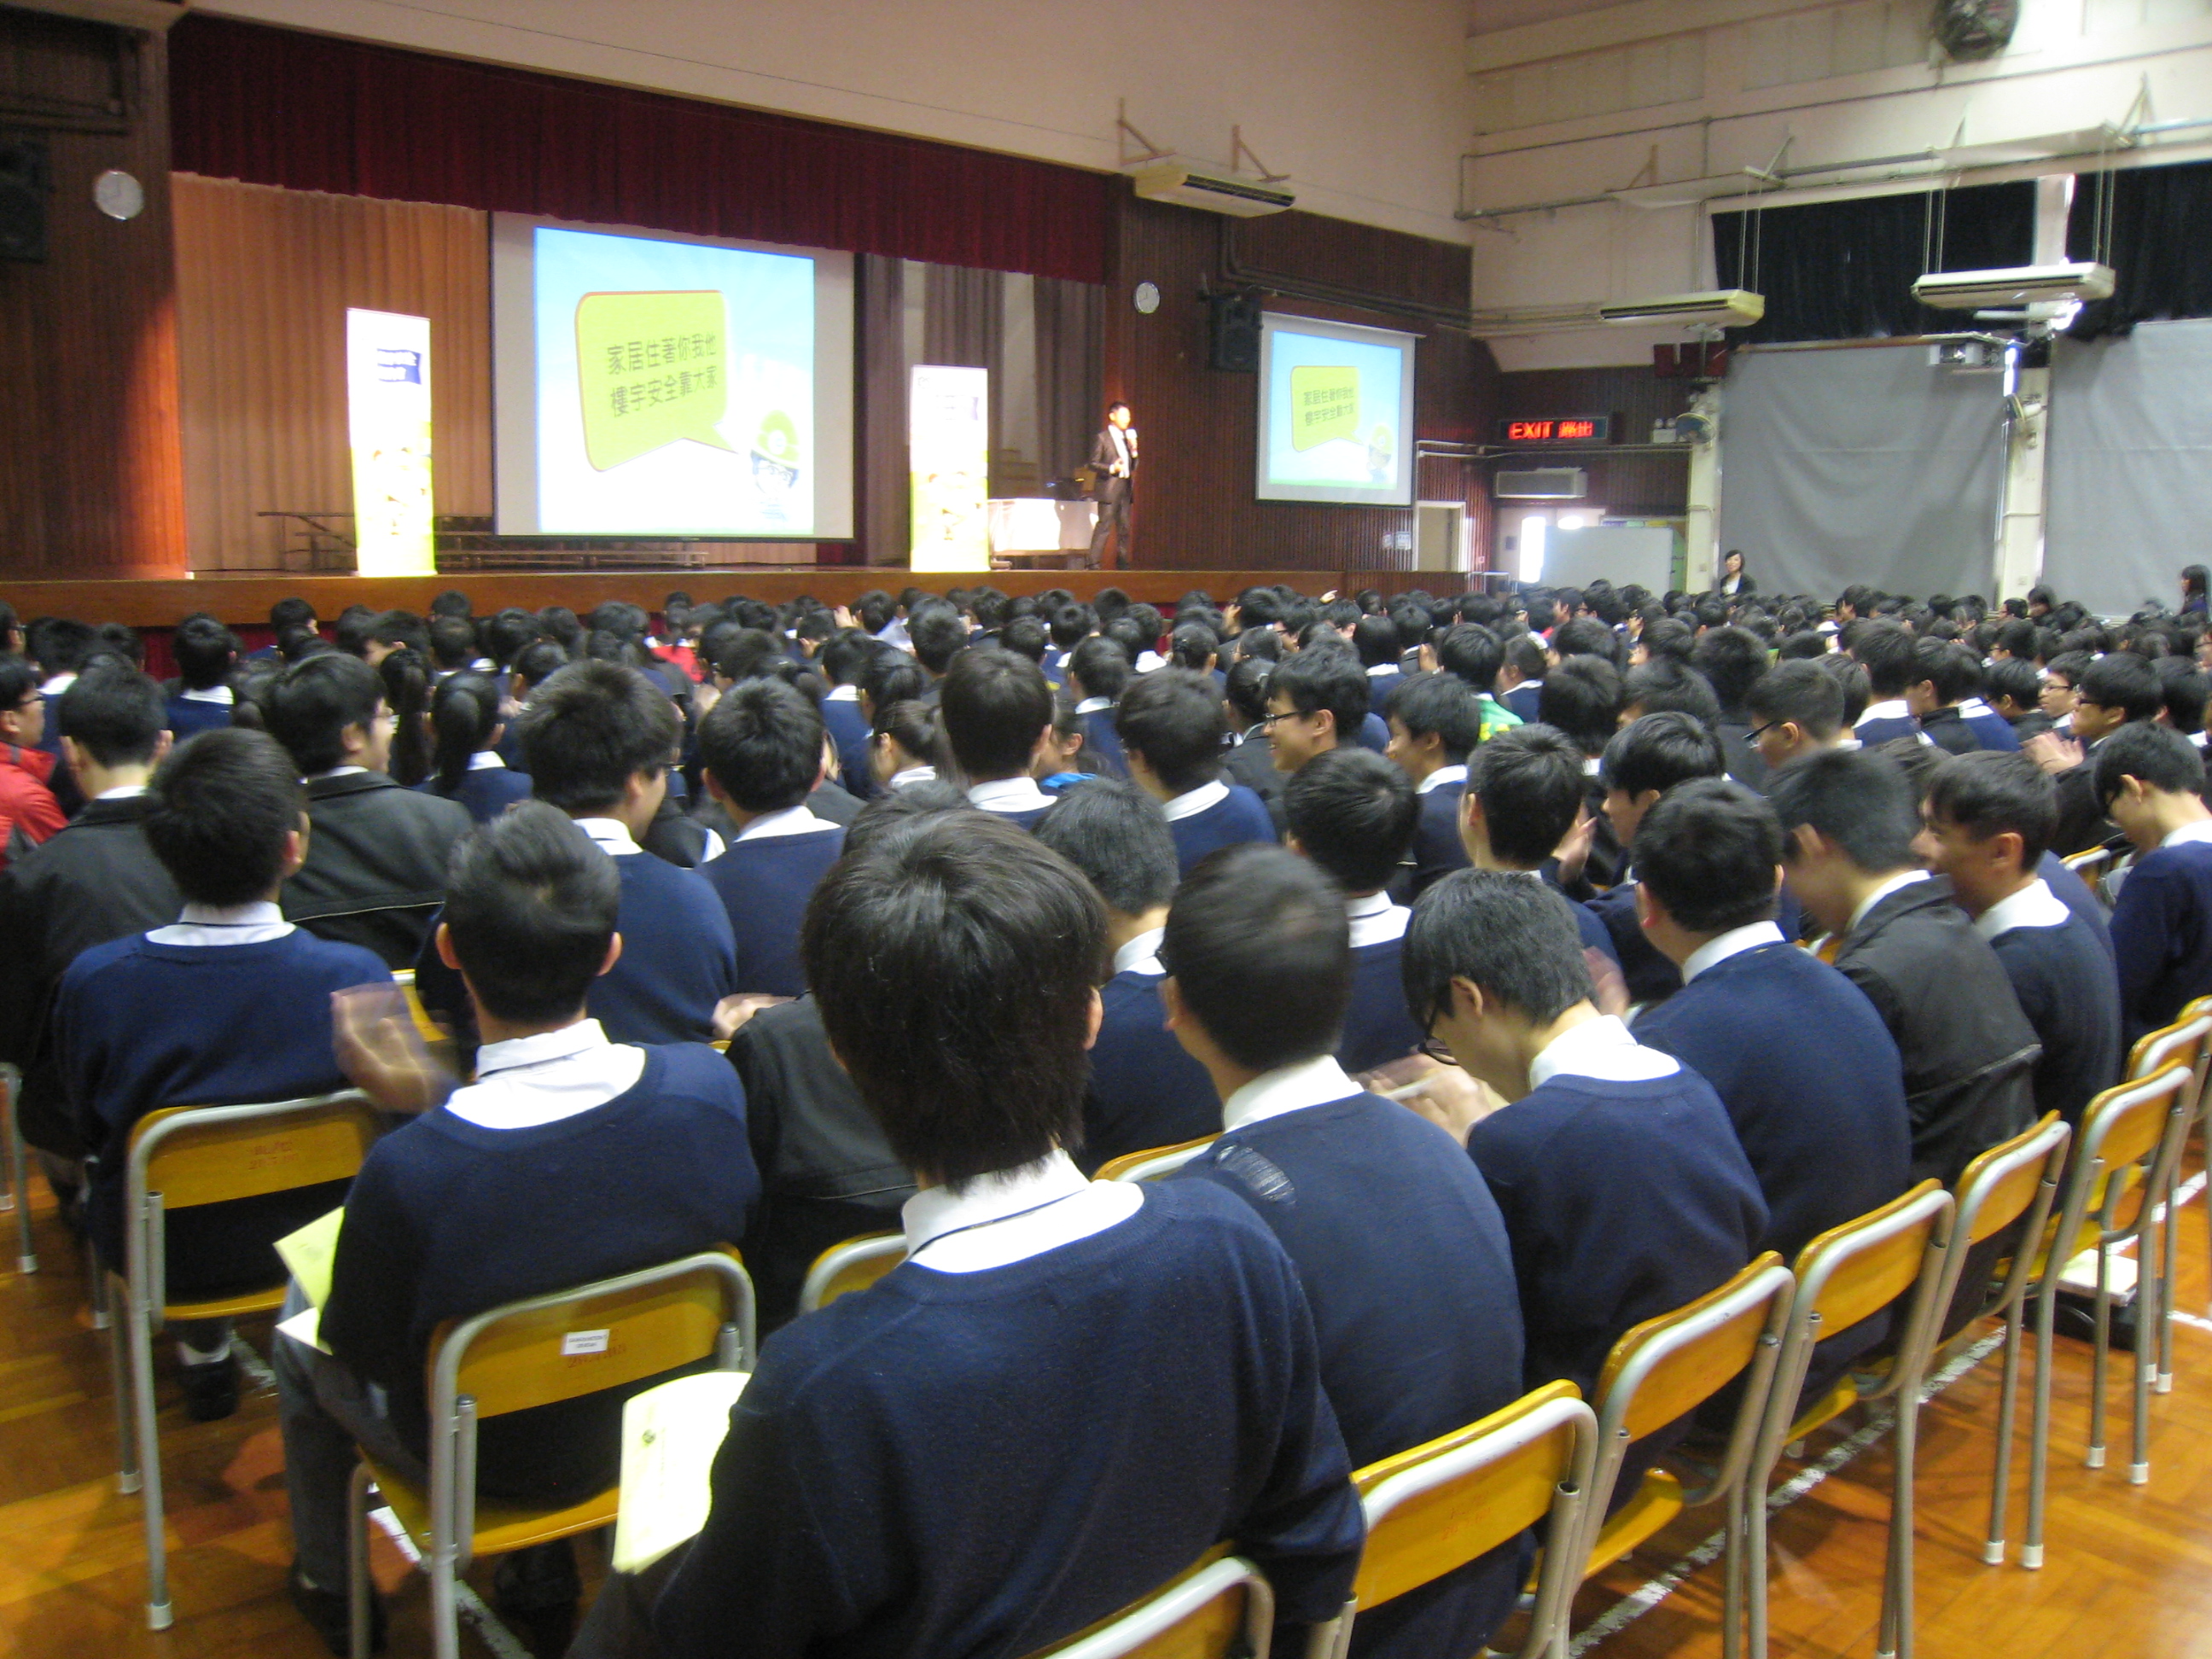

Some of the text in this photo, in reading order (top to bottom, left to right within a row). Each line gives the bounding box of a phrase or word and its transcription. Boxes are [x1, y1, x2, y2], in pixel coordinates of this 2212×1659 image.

[607, 332, 716, 375] 家居住著你我他
[610, 365, 717, 417] 樓宇安全靠大家
[1508, 422, 1553, 439] EXIT
